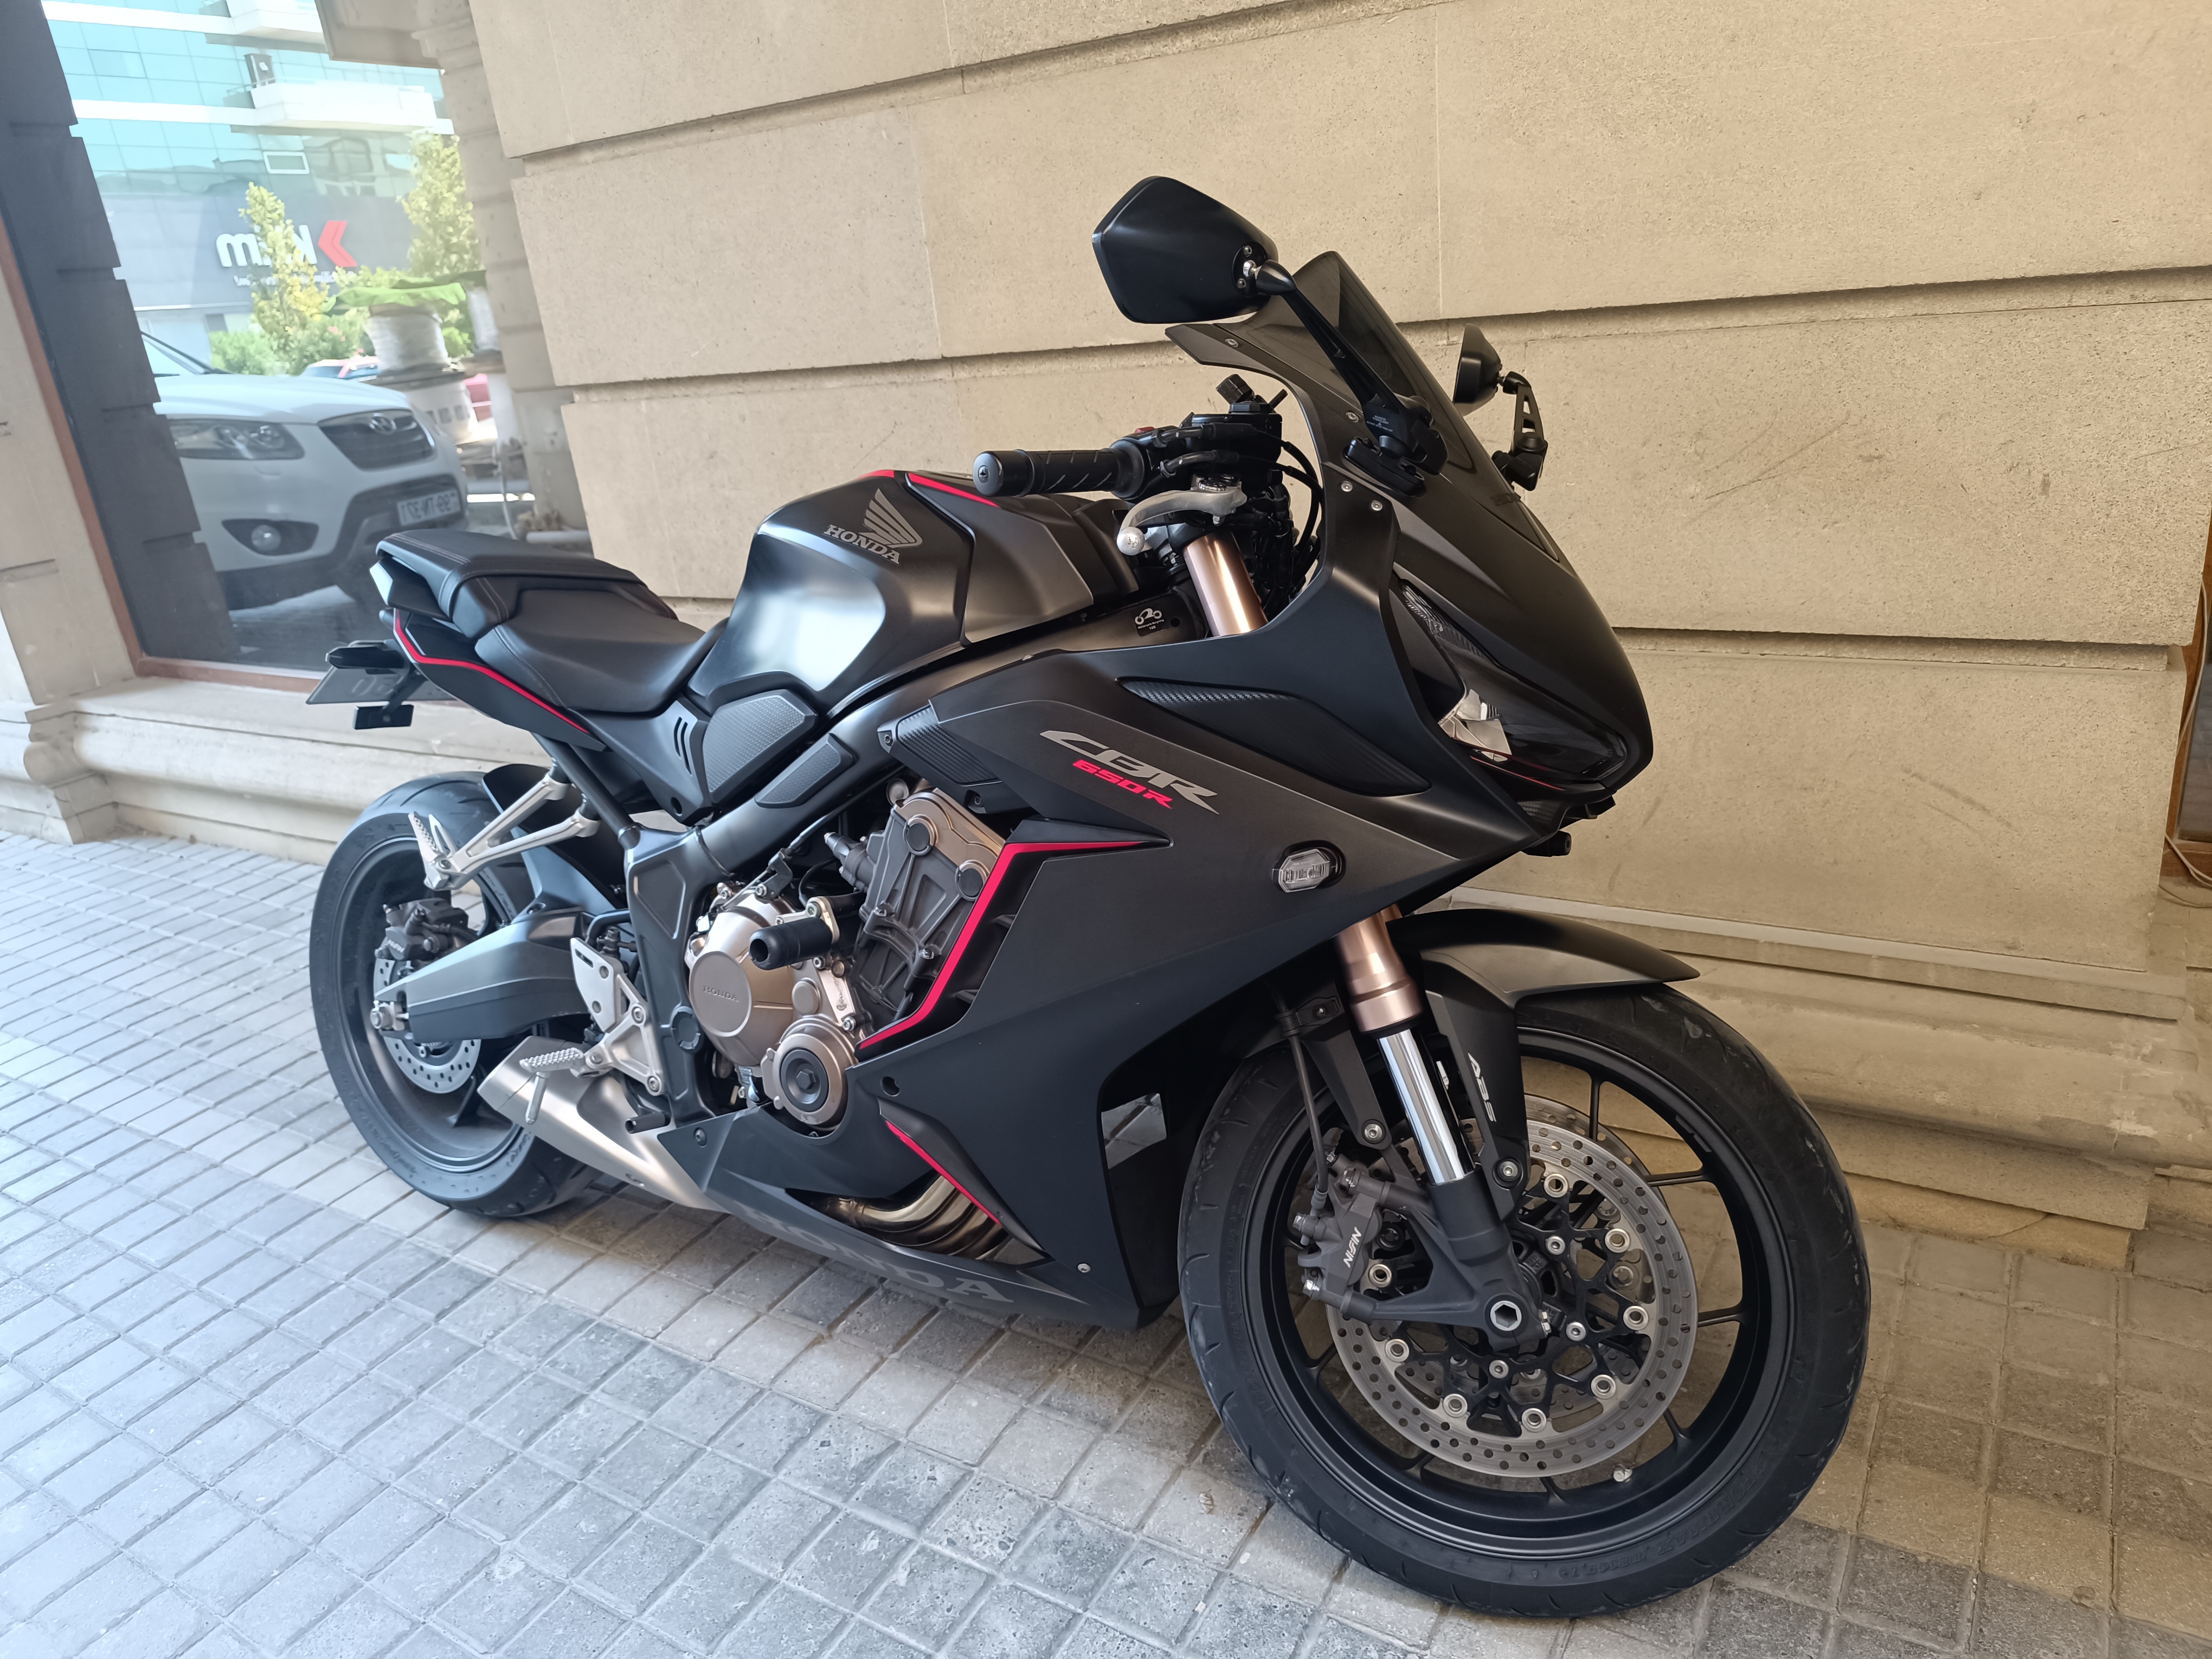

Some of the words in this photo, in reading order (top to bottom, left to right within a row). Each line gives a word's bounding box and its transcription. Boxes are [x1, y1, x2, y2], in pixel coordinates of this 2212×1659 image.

[823, 524, 900, 564] HONDA
[1040, 730, 1219, 815] CBR
[1072, 760, 1173, 809] 650R
[703, 985, 740, 1002] HONDA
[1467, 1052, 1497, 1122] ABS
[734, 1201, 1014, 1303] HONDA
[1655, 1456, 1769, 1556] SPORTMAX
